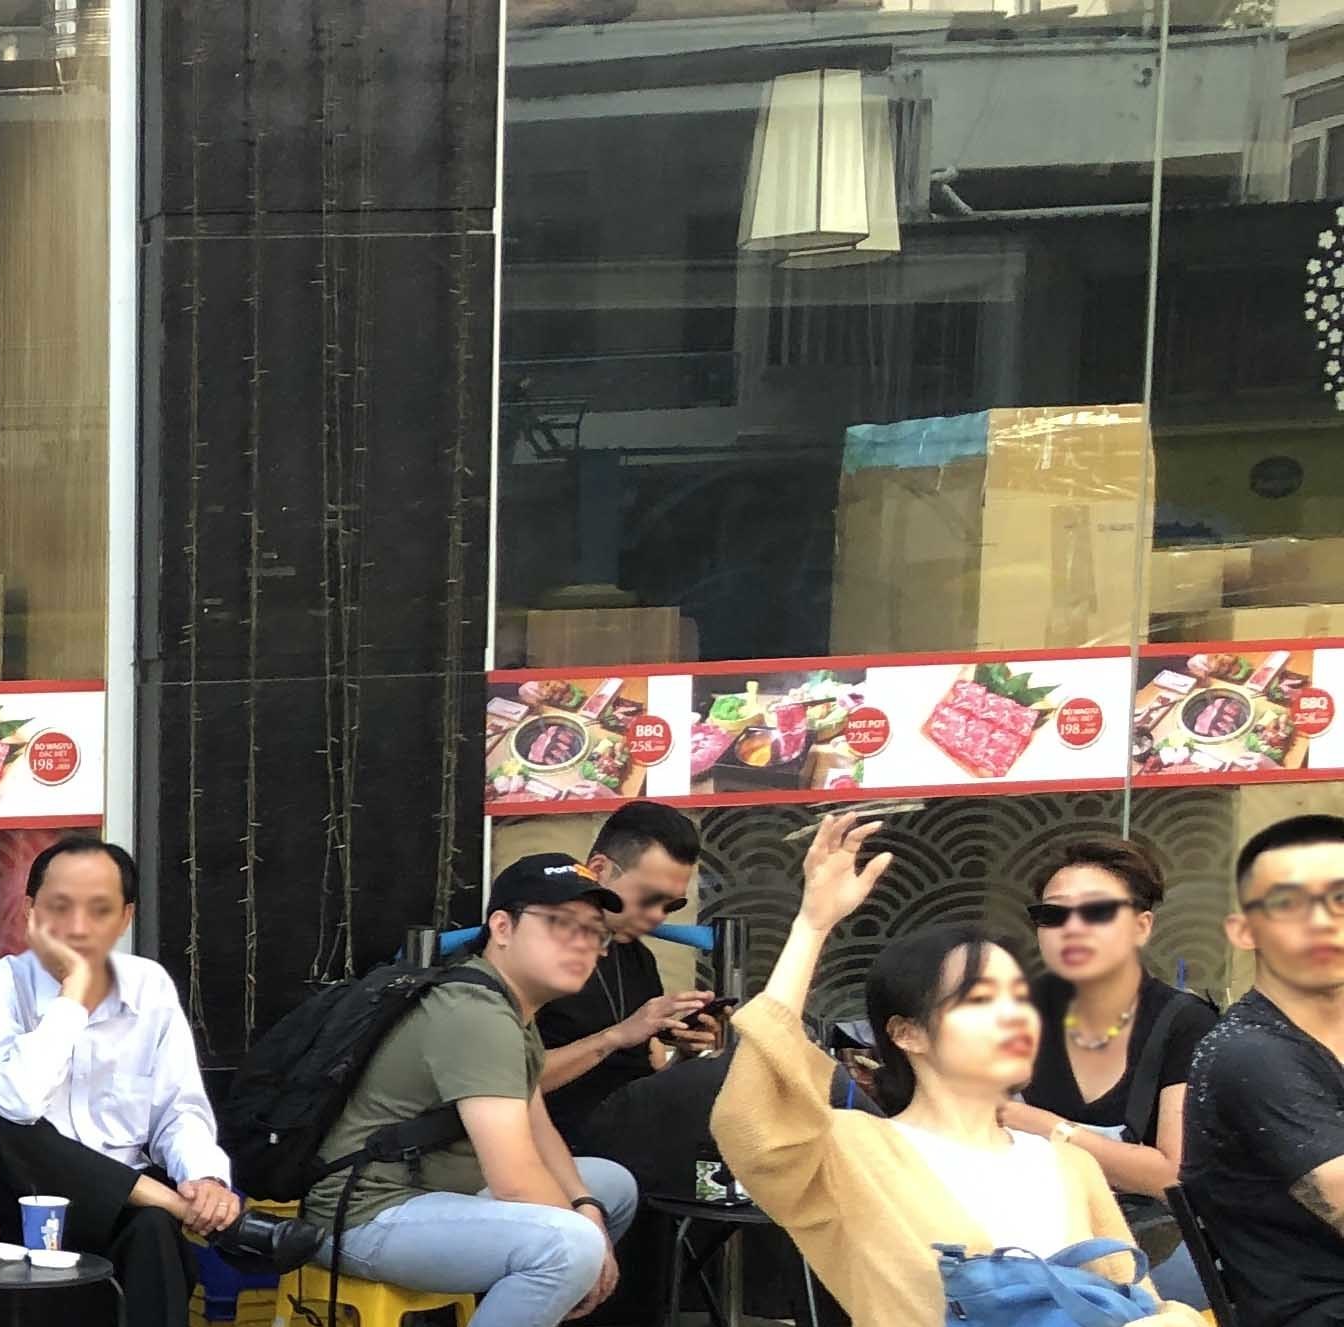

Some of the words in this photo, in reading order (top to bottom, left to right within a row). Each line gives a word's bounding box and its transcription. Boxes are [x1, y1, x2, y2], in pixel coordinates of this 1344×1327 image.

[1300, 697, 1328, 710] BBQ
[636, 724, 664, 737] BBQ
[848, 720, 866, 729] HOT
[868, 719, 887, 728] POT
